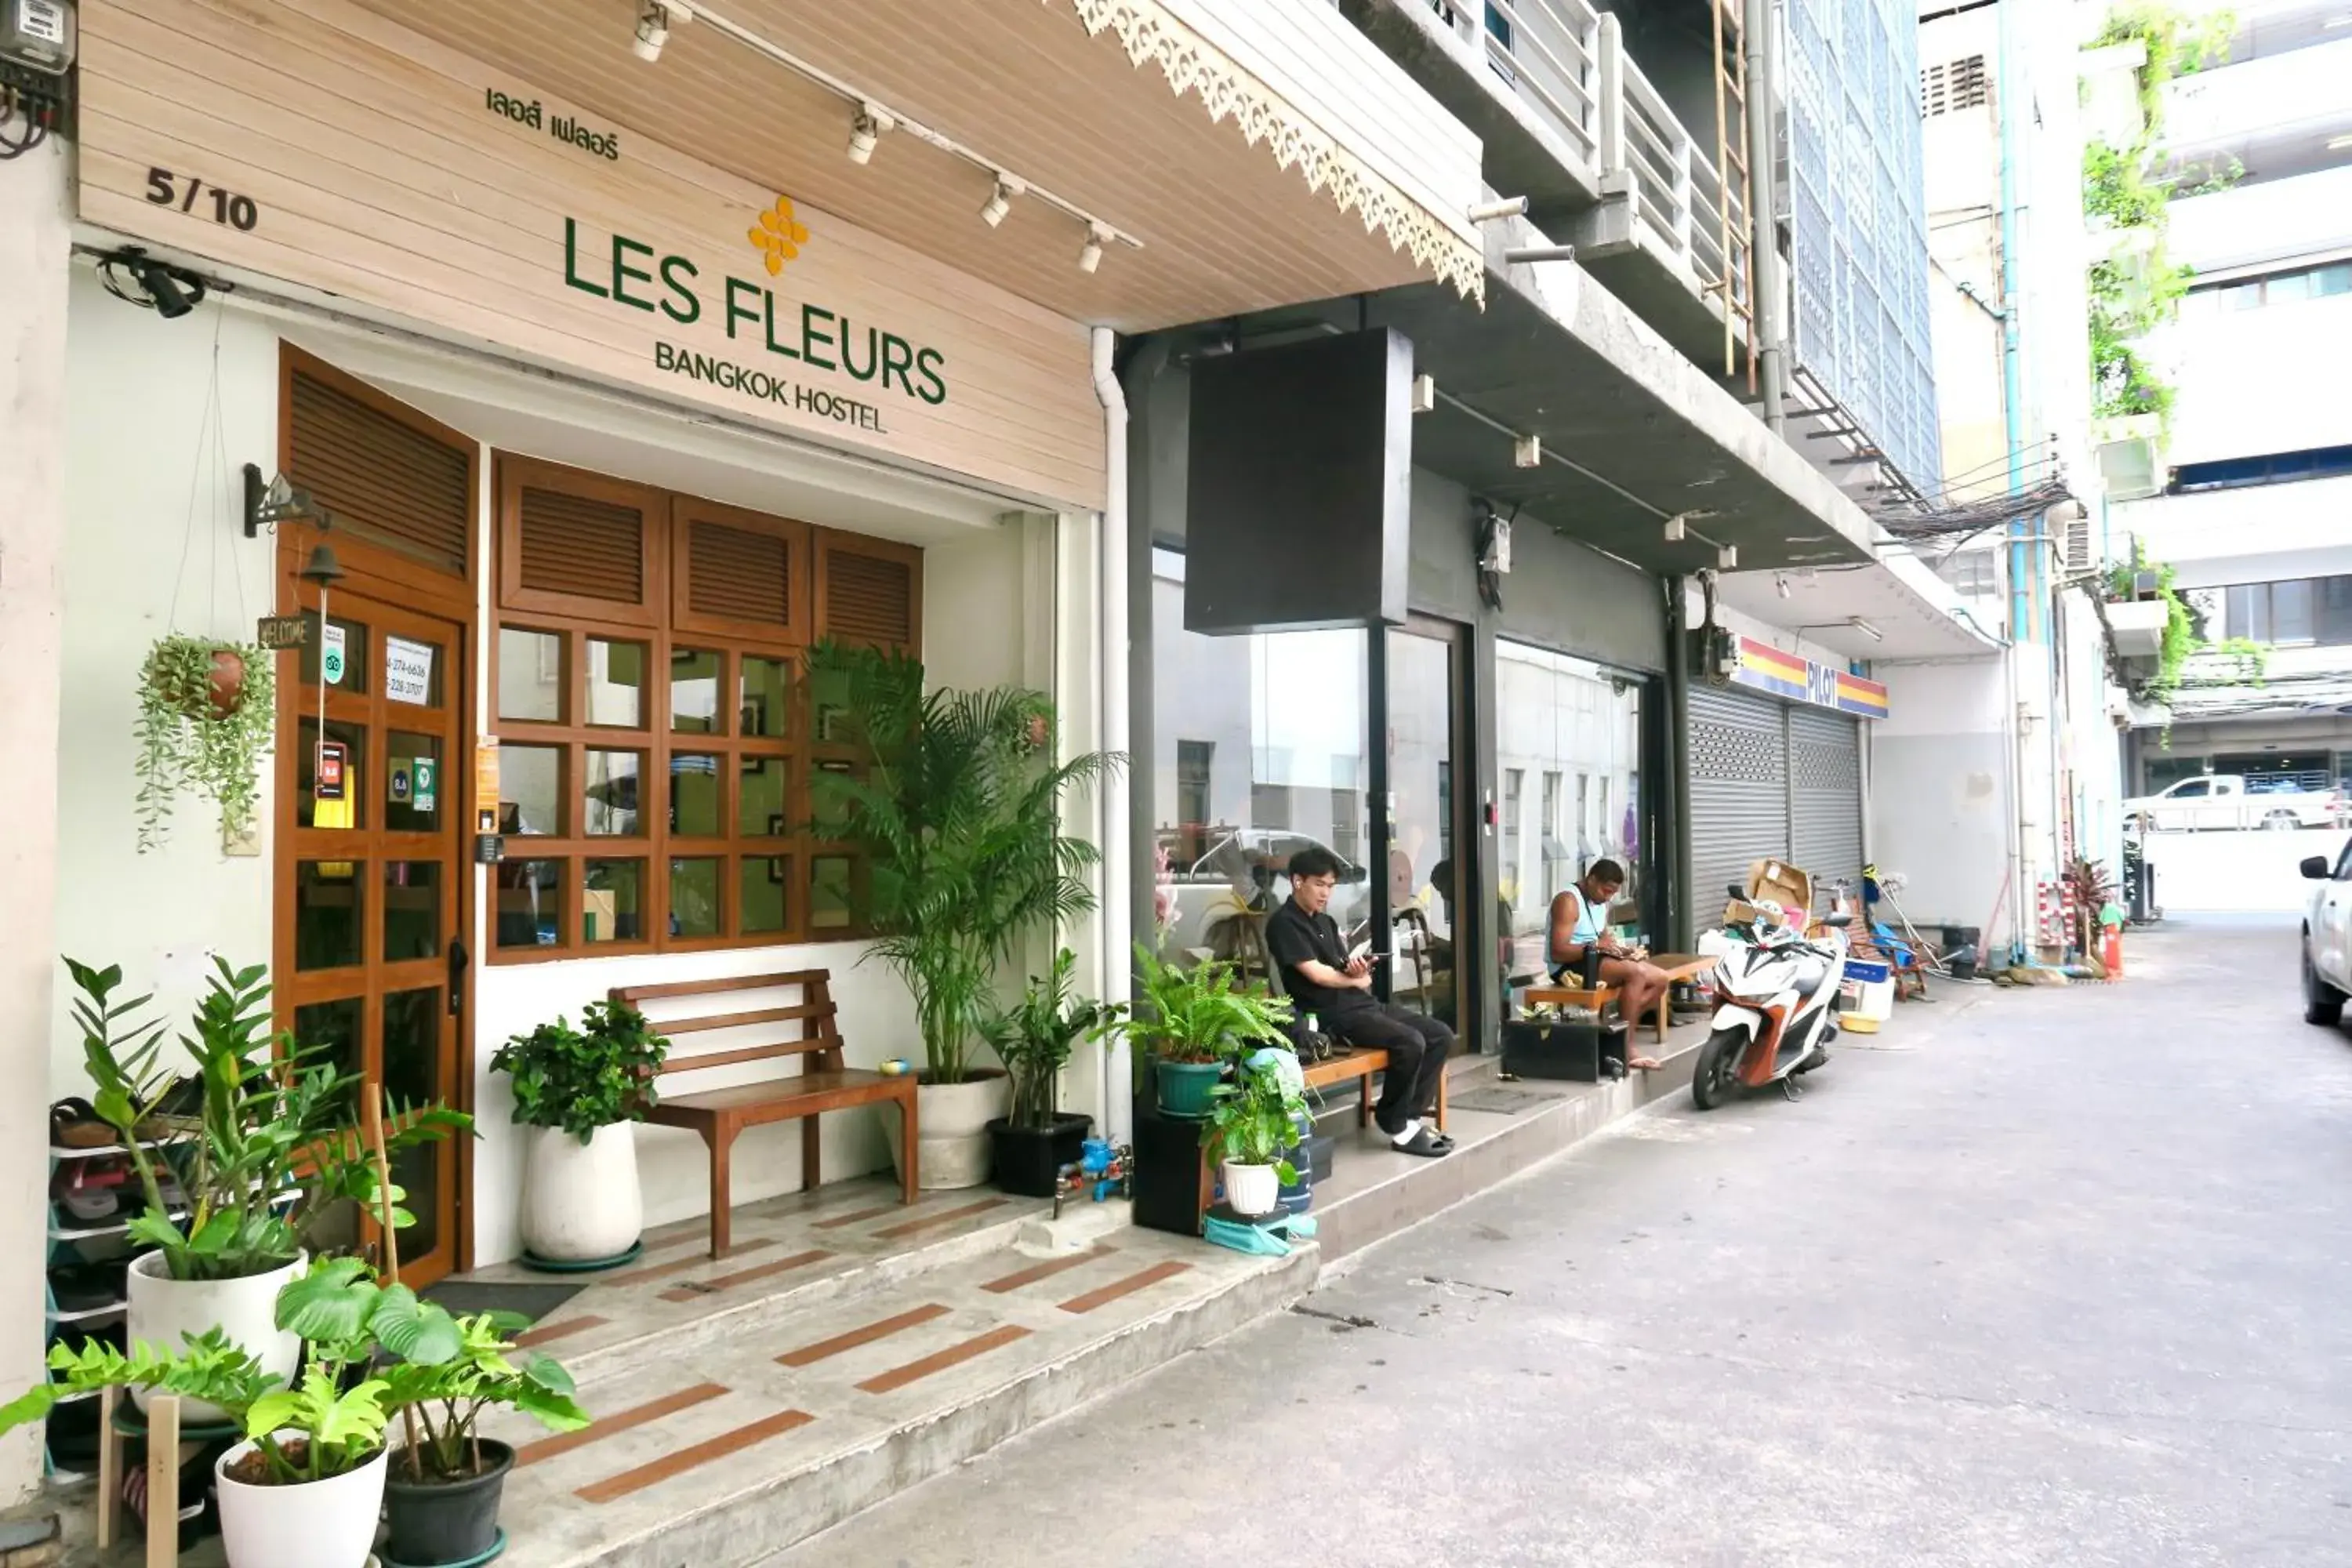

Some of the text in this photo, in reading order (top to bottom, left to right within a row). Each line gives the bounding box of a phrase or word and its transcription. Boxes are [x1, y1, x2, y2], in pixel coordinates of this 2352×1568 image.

[486, 88, 619, 161] เลอส์ เฟลอร์
[565, 216, 946, 405] LES FLEURS
[655, 341, 888, 434] BANGKOK HOSTEL
[260, 619, 308, 644] WELCOME
[1808, 661, 1836, 706] PILOT
